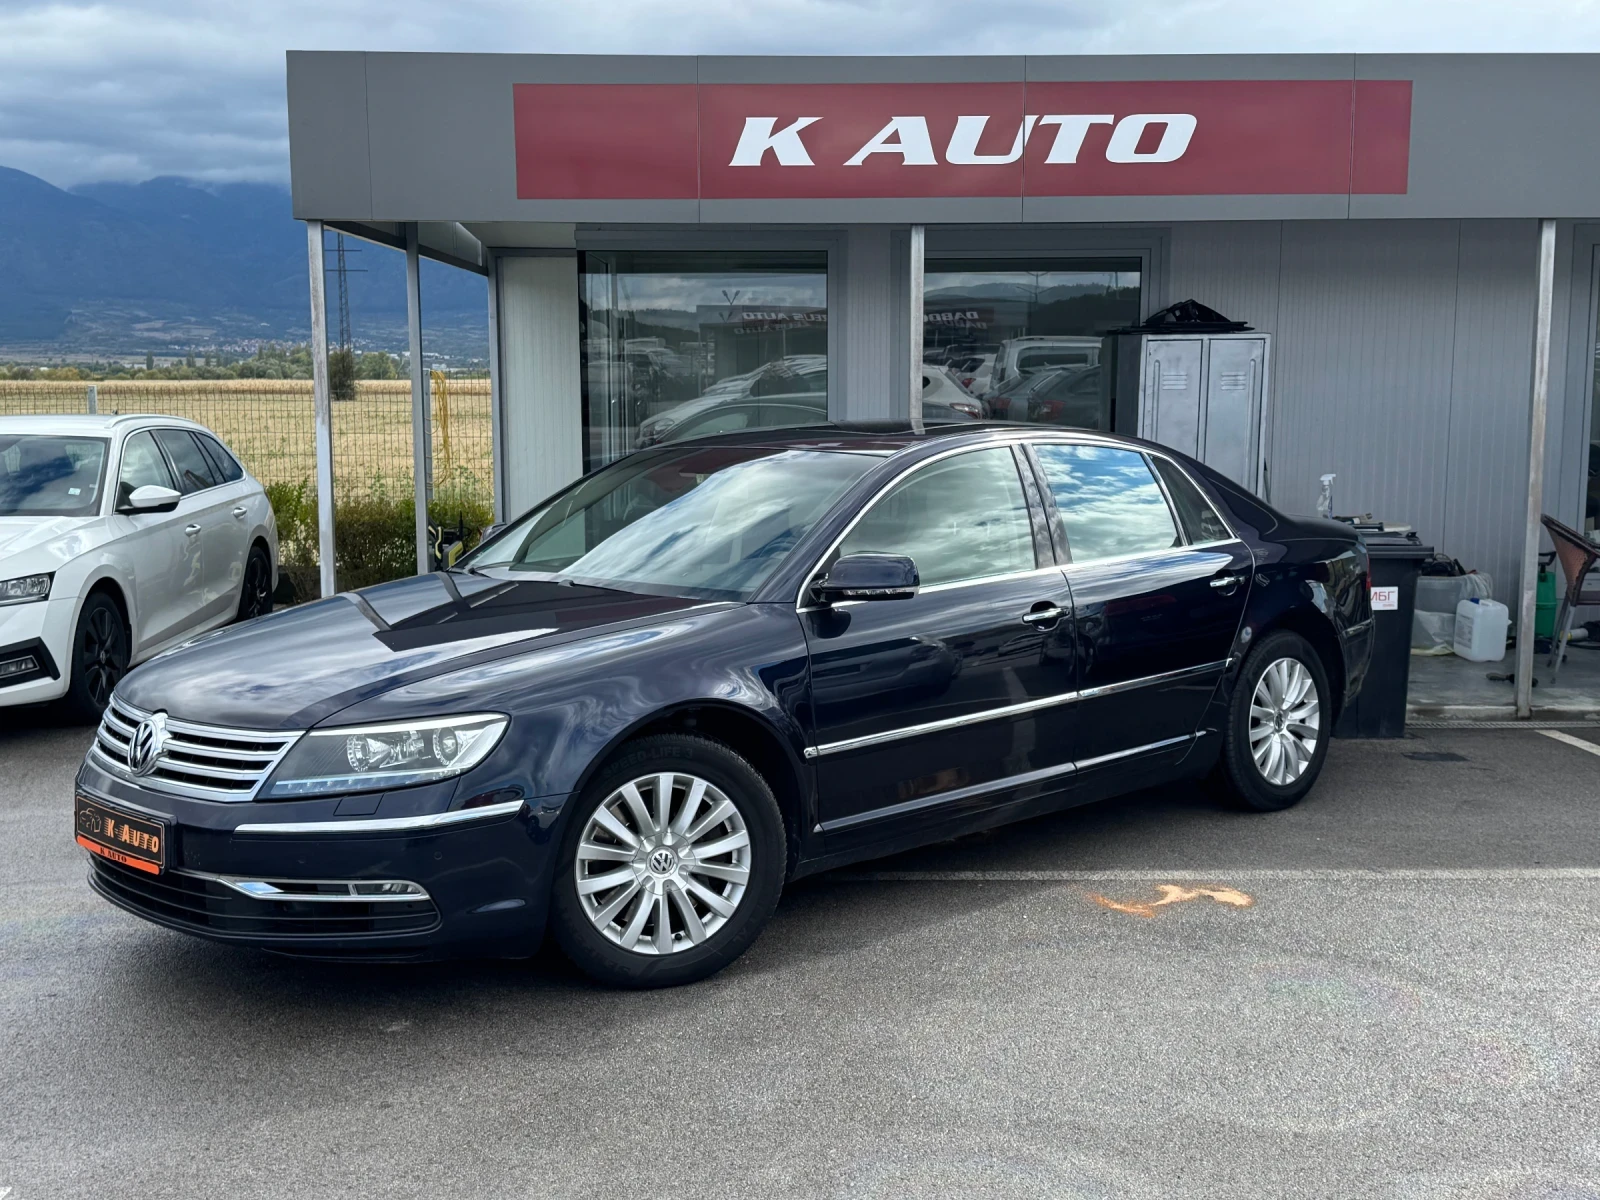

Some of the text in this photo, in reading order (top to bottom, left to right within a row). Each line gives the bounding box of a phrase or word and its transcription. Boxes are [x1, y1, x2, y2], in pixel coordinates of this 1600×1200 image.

[728, 113, 1198, 167] K AUTO
[108, 850, 127, 862] AUTO
